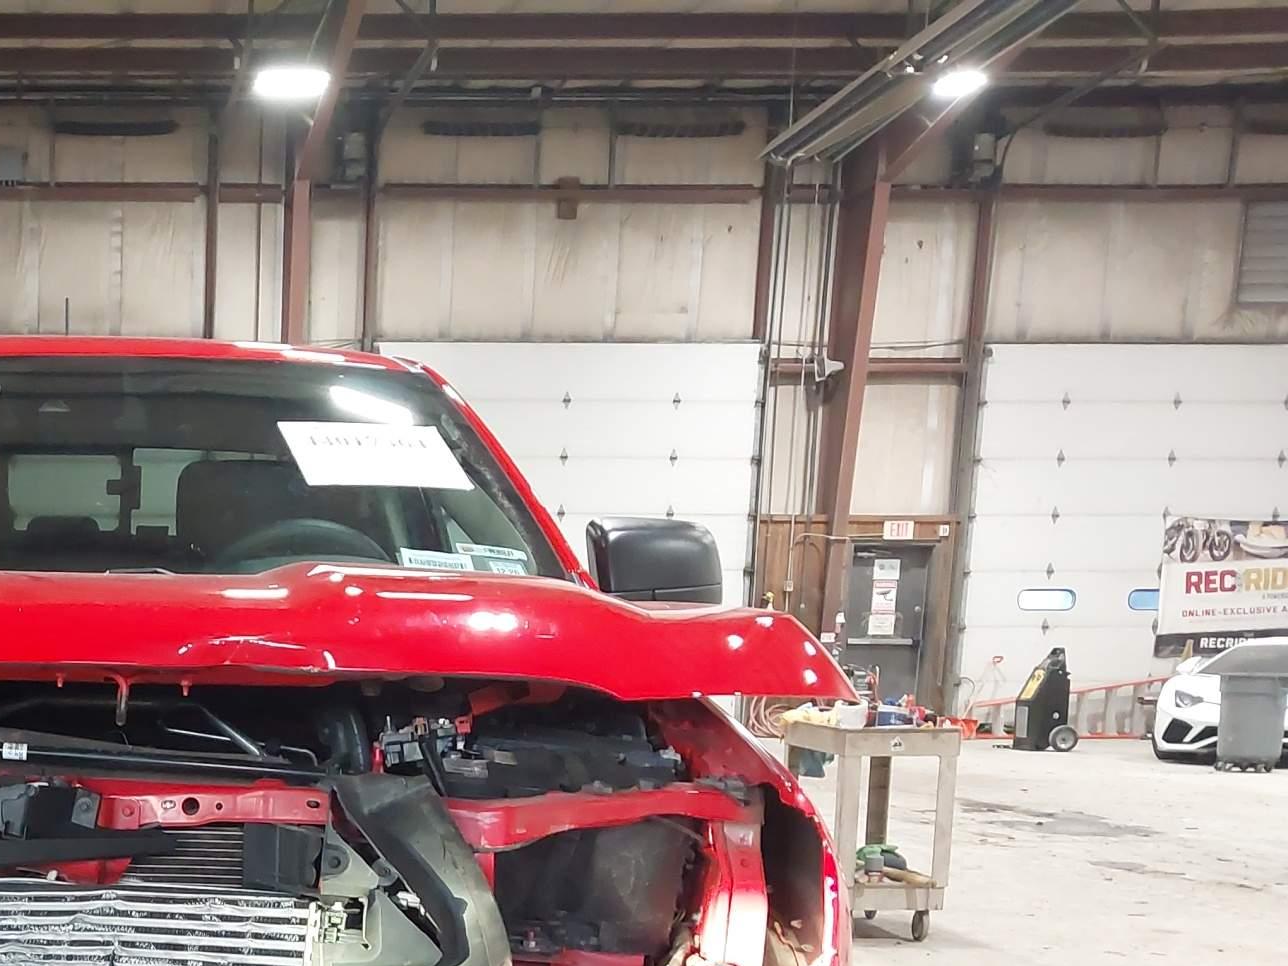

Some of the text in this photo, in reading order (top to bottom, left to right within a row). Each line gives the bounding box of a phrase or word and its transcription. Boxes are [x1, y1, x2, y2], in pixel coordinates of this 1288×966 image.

[889, 522, 909, 537] EXIT
[1185, 570, 1237, 594] REC
[1182, 606, 1277, 617] ONLINE-EXCLUSIVE
